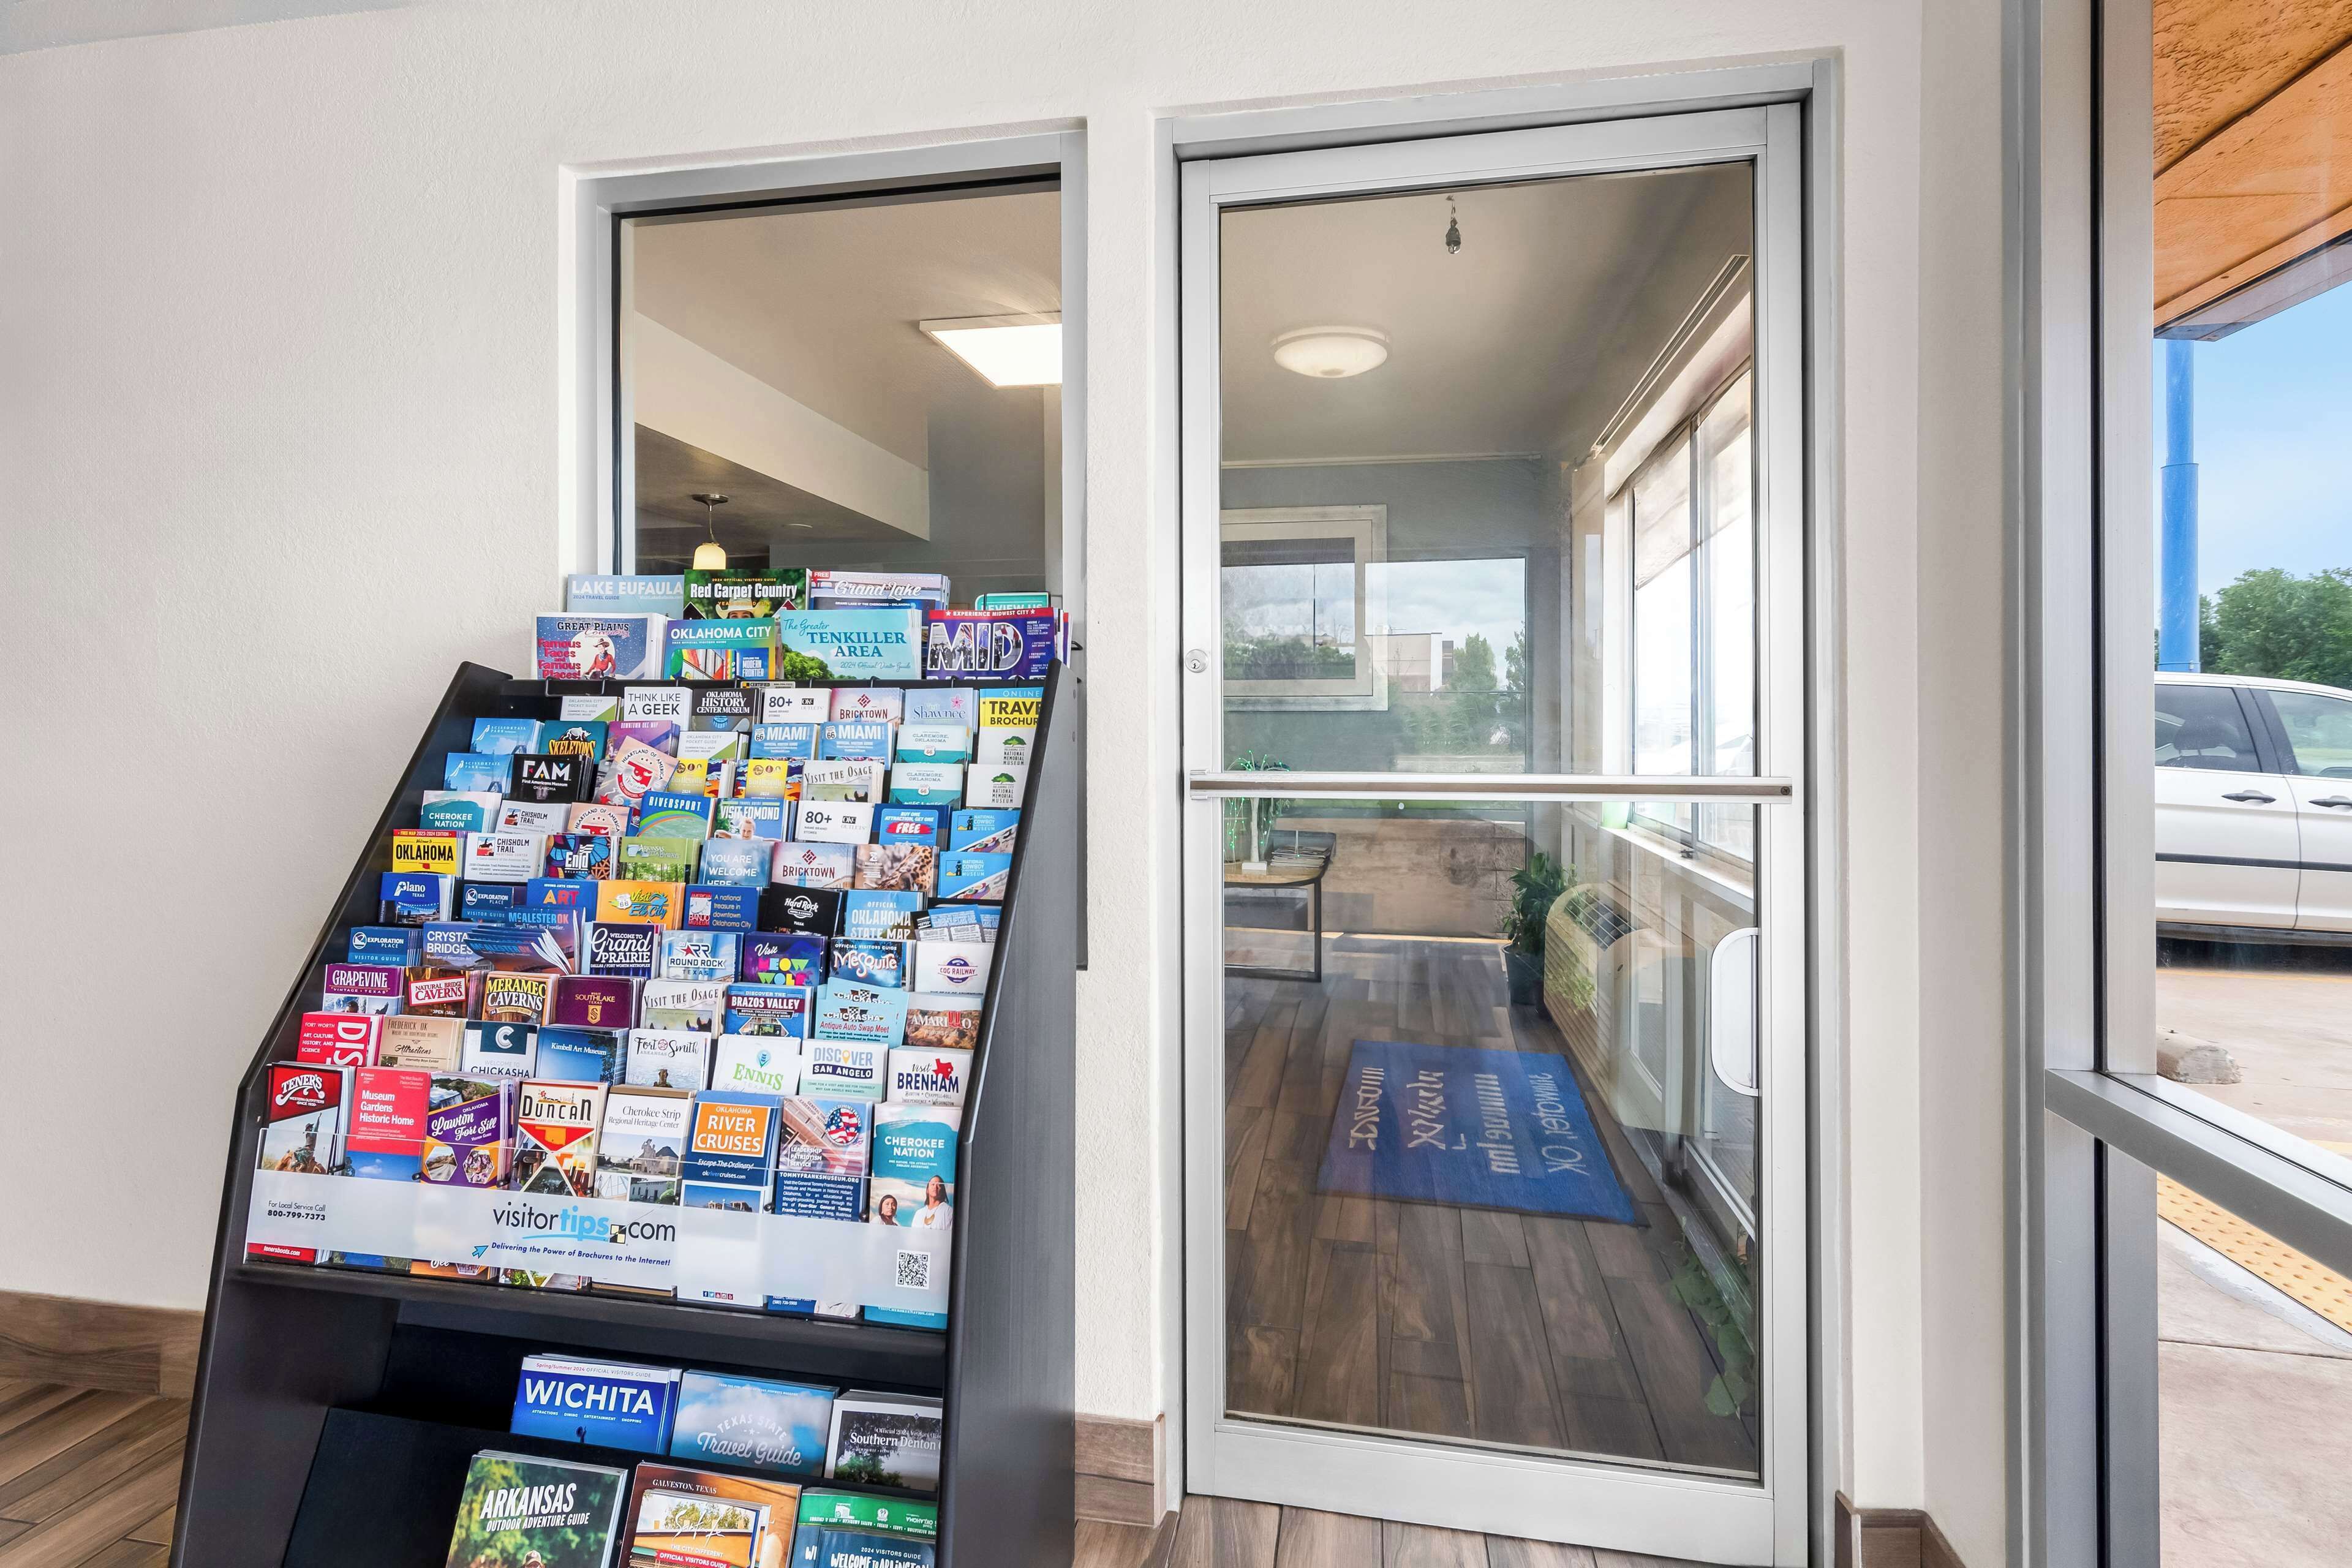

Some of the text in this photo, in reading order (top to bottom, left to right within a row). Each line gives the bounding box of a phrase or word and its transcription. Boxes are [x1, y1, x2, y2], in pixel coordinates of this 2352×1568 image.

[572, 581, 683, 595] LAKE EUFAULA
[690, 584, 797, 599] Red Carpet Country
[835, 580, 921, 601] Grand Lake
[557, 622, 630, 631] GREAT PLAINS
[671, 626, 772, 639] OKLAHOMA CITY
[784, 618, 829, 636] The Greater
[537, 638, 581, 649] Famous
[807, 632, 907, 644] TENKILLER
[544, 648, 576, 658] Faces
[834, 646, 883, 657] AREA
[927, 622, 1023, 671] MID
[538, 660, 581, 671] Famous
[628, 693, 657, 702] THINK
[702, 698, 747, 707] HISTORY
[769, 696, 793, 707] 80+
[628, 704, 680, 715] A GEEK
[840, 709, 888, 720] BRICKTOWN
[913, 705, 966, 720] Shawnee
[548, 739, 595, 757] SKELETONS
[649, 796, 701, 811] RIVERSPORT
[895, 823, 921, 834] FREE
[497, 837, 530, 847] CHISHOLM
[396, 844, 454, 861] OKLAHOMA
[497, 845, 515, 854] TRAIL
[709, 867, 756, 876] WELCOME
[394, 881, 426, 896] Plano
[852, 910, 911, 925] OKLAHOMA
[590, 928, 652, 962] Grand
[755, 943, 778, 956] Visit
[601, 952, 650, 963] PRAIRIE
[758, 958, 809, 971] MEOW
[333, 970, 388, 988] GRAPEVINE
[415, 987, 463, 1001] CAVERNS
[487, 979, 546, 998] MERAMEC
[488, 992, 543, 1011] CAVERNS
[575, 994, 615, 1003] SOUTHLAKE
[731, 997, 800, 1010] BRAZOS VALLEY
[826, 1012, 881, 1021] CHICKASHA
[820, 1022, 843, 1031] Antique
[859, 1024, 874, 1033] Swap
[551, 1042, 573, 1051] Kimbell
[635, 1037, 699, 1057] Fort Smith
[471, 1066, 529, 1078] CHICKASHA
[734, 1063, 784, 1091] ENNIS
[836, 1067, 872, 1078] ANGELO
[281, 1074, 323, 1094] TENER'S
[897, 1072, 959, 1093] BRENHAM
[362, 1090, 395, 1101] Museum
[361, 1102, 393, 1112] Gardens
[462, 1102, 489, 1113] OKLAHOMA
[522, 1095, 591, 1121] DUNCAN
[623, 1106, 680, 1120] Cherokee Strip
[715, 1106, 752, 1115] OKLAHOMA
[360, 1113, 414, 1126] Historic Home
[431, 1114, 474, 1136] Lawton
[608, 1116, 633, 1126] Regional
[633, 1117, 658, 1128] Heritage
[707, 1115, 755, 1133] RIVER
[455, 1117, 497, 1141] Fort Sill
[696, 1134, 762, 1152] CRUISES
[884, 1136, 944, 1148] CHEROKEE
[893, 1147, 934, 1158] NATION
[702, 1170, 746, 1180] okrivercruises.com
[779, 1172, 859, 1183] TOMMYFRANKSMUSEUM.ORG
[294, 1202, 313, 1211] Service
[268, 1210, 326, 1221] 800-799-7373
[491, 1242, 527, 1253] Delivering
[543, 1246, 565, 1256] Power
[578, 1251, 613, 1261] Brochures
[639, 1256, 671, 1265] Internet!
[525, 1378, 654, 1415] WICHITA
[717, 1414, 788, 1441] TEXAS STATE
[850, 1432, 936, 1450] Southern Denton
[697, 1431, 802, 1467] Travel Guide
[652, 1479, 717, 1494] GALVESTON, TEXAS
[480, 1482, 577, 1520] ARKANSAS
[486, 1512, 590, 1532] OUTDOOR ADVENTURE GUIDE
